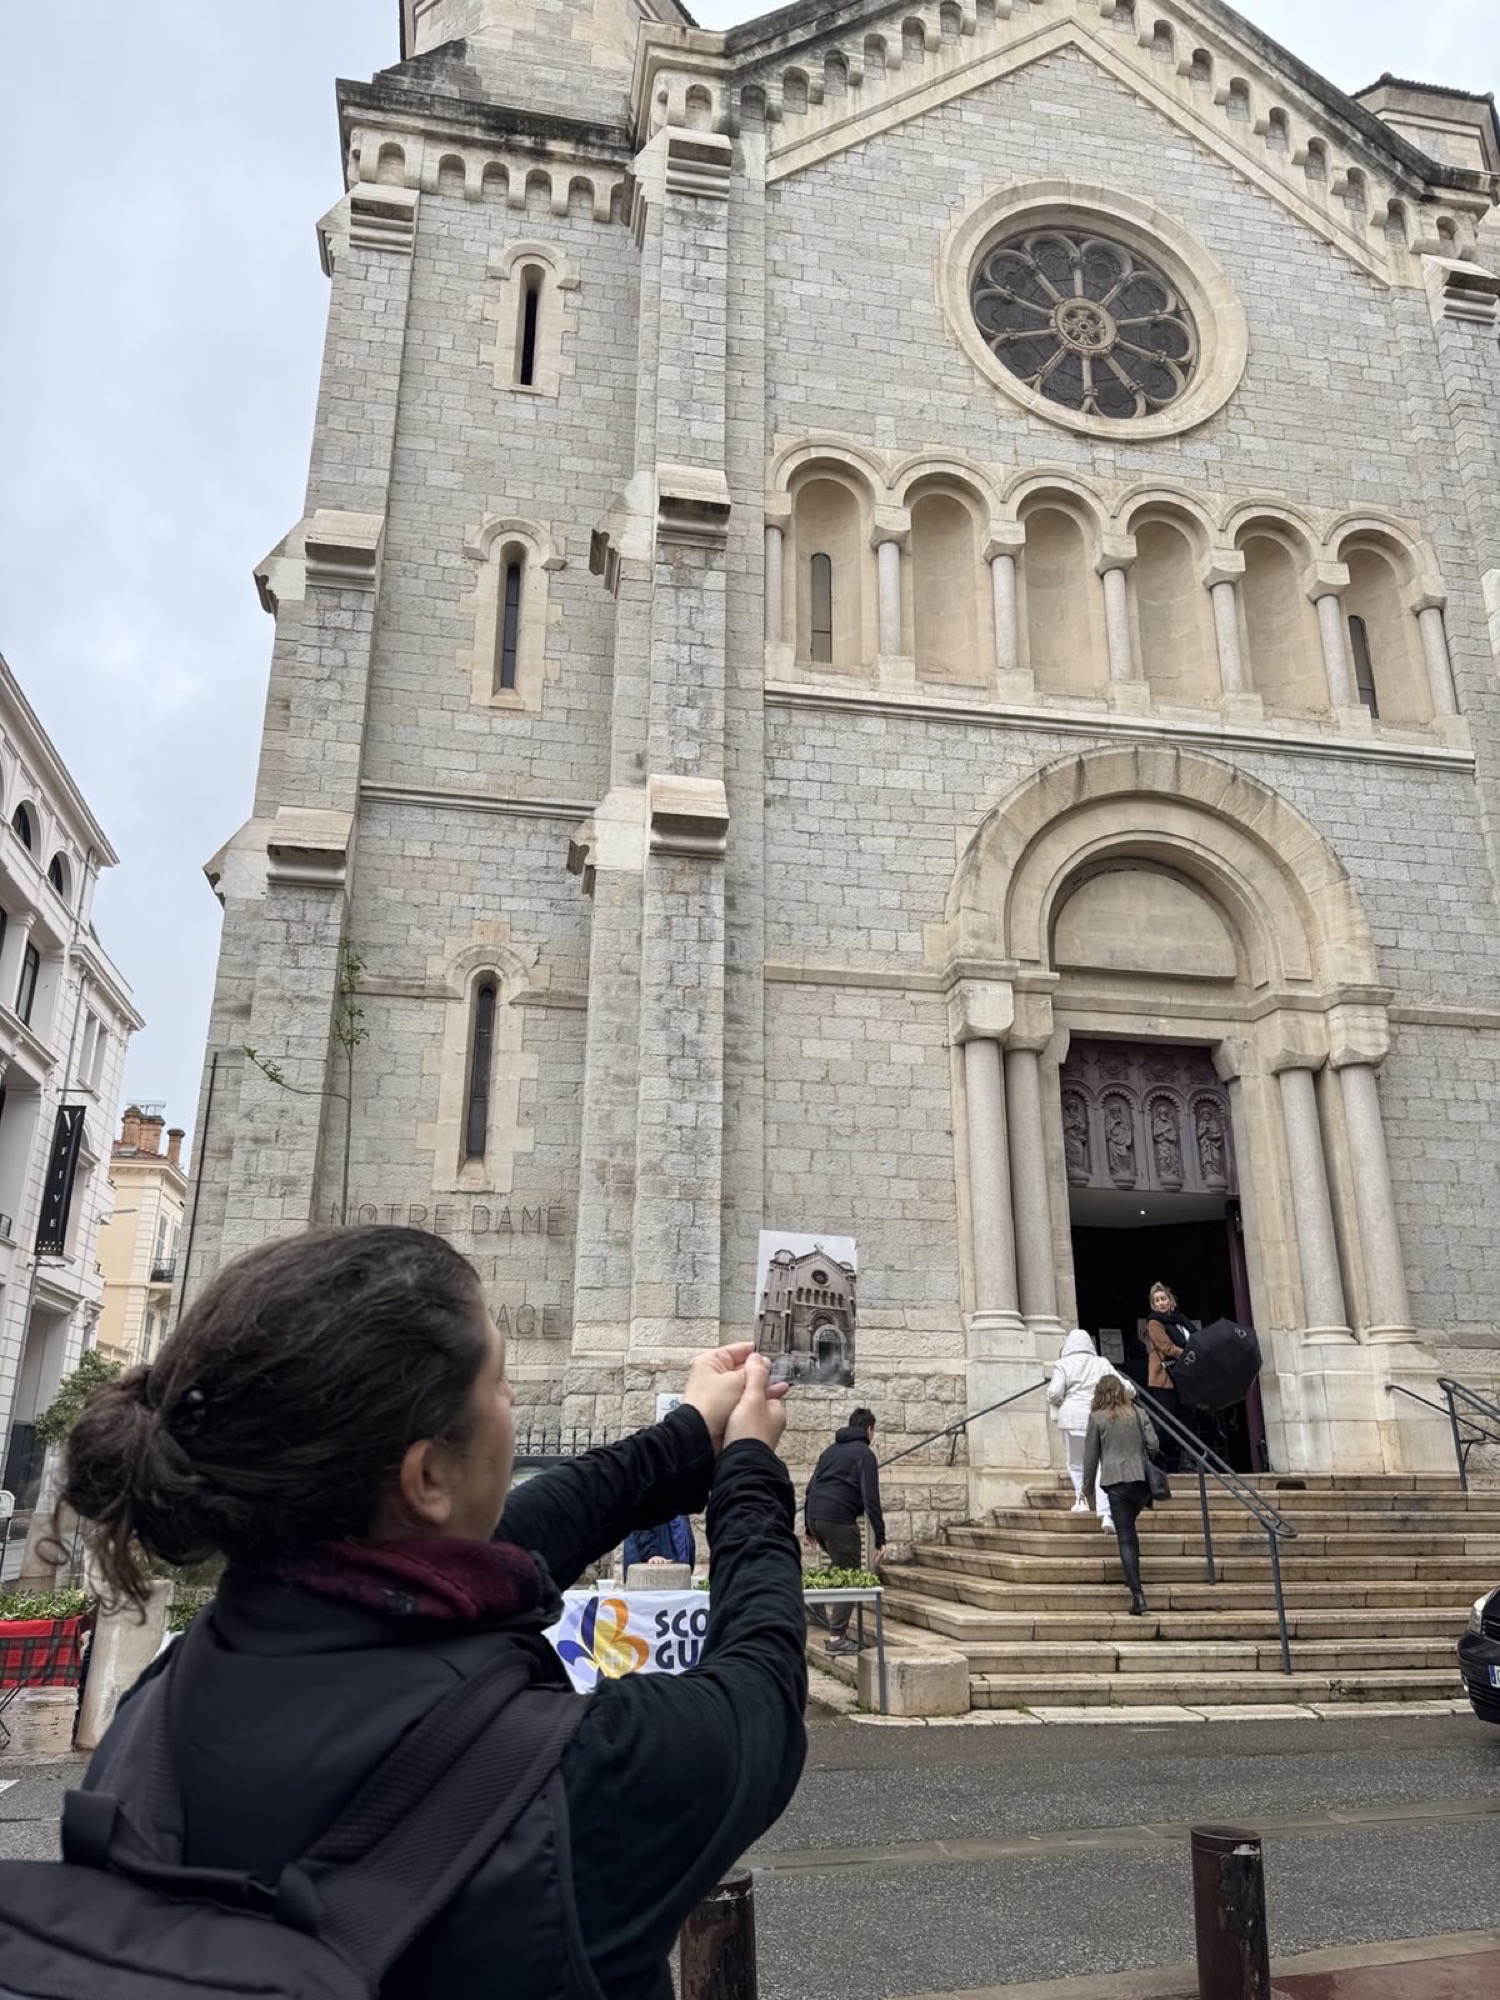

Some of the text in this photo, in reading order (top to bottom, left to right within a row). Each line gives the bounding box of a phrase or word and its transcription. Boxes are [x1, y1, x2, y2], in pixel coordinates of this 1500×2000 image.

[50, 1146, 68, 1227] FIVE
[329, 1202, 567, 1237] NOTRE DAME
[487, 1303, 563, 1335] AGE
[654, 1608, 709, 1639] SCO
[655, 1639, 700, 1670] GU
